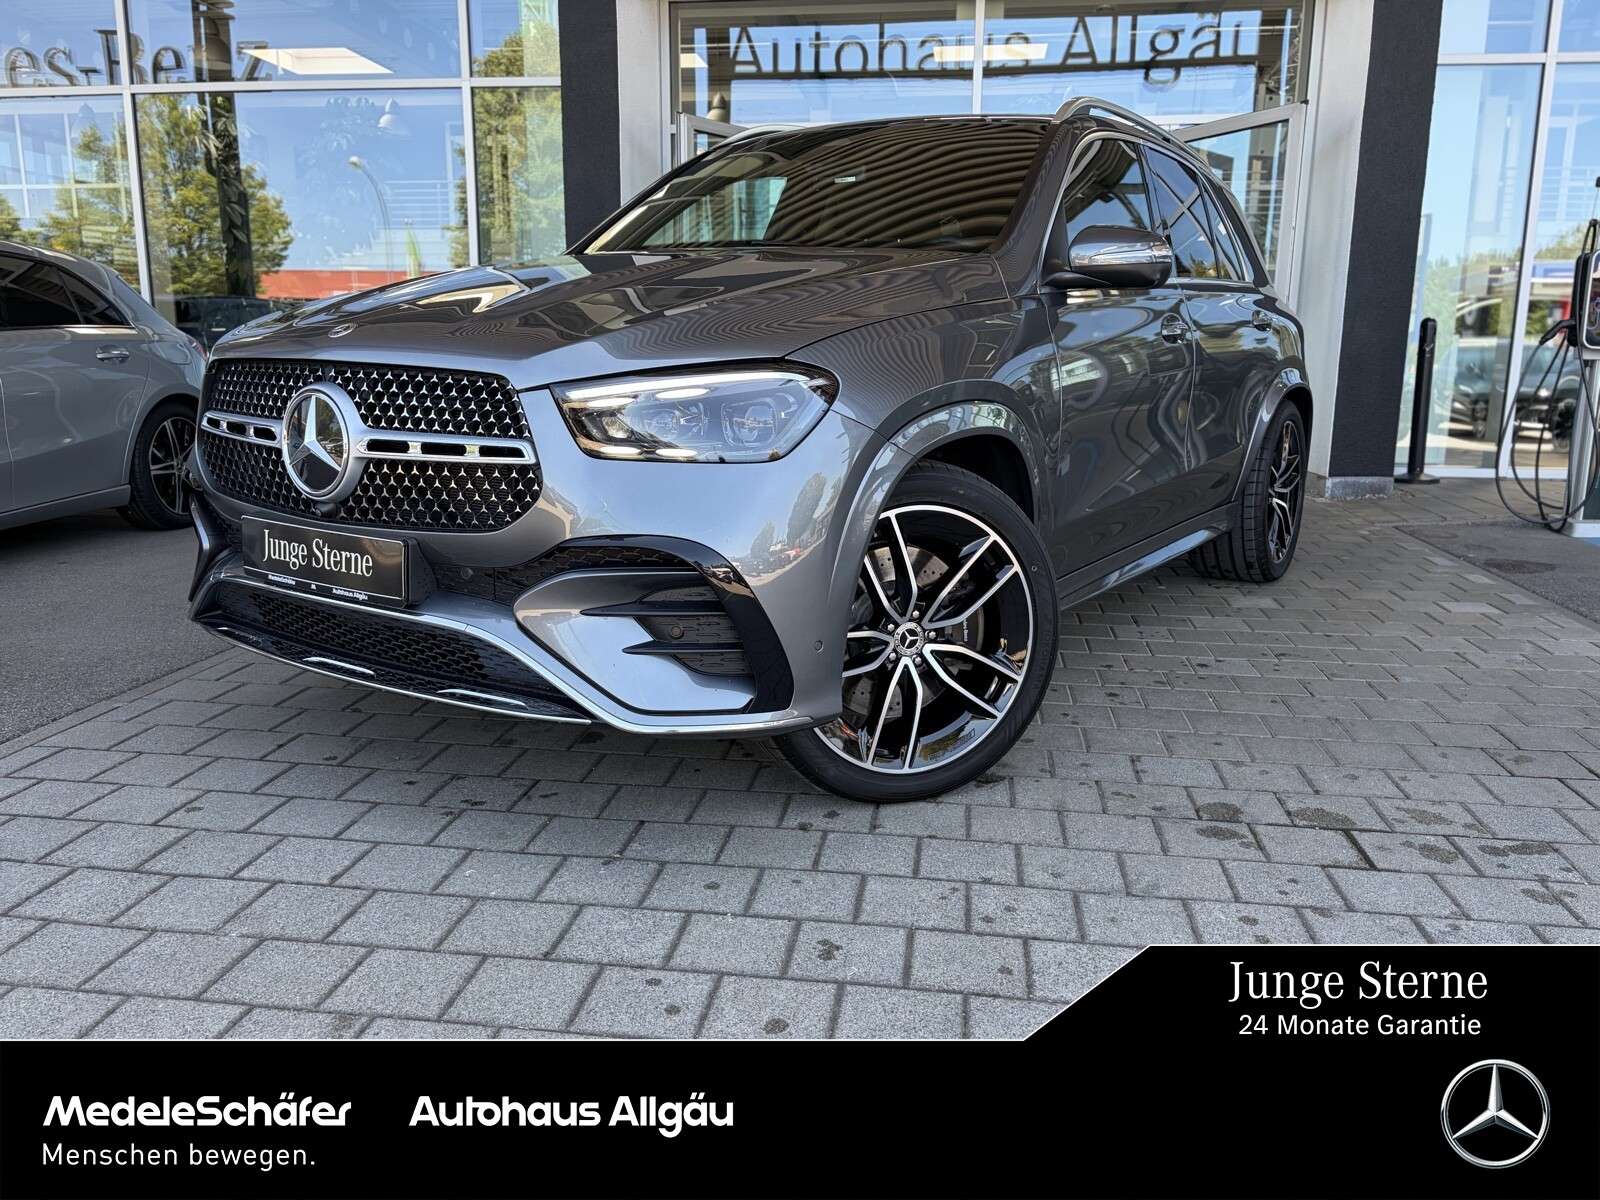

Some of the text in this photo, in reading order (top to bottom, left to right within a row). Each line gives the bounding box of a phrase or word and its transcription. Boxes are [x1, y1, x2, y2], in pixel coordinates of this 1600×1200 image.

[729, 22, 1031, 74] Autohaus
[263, 529, 373, 577] Junge Sterne
